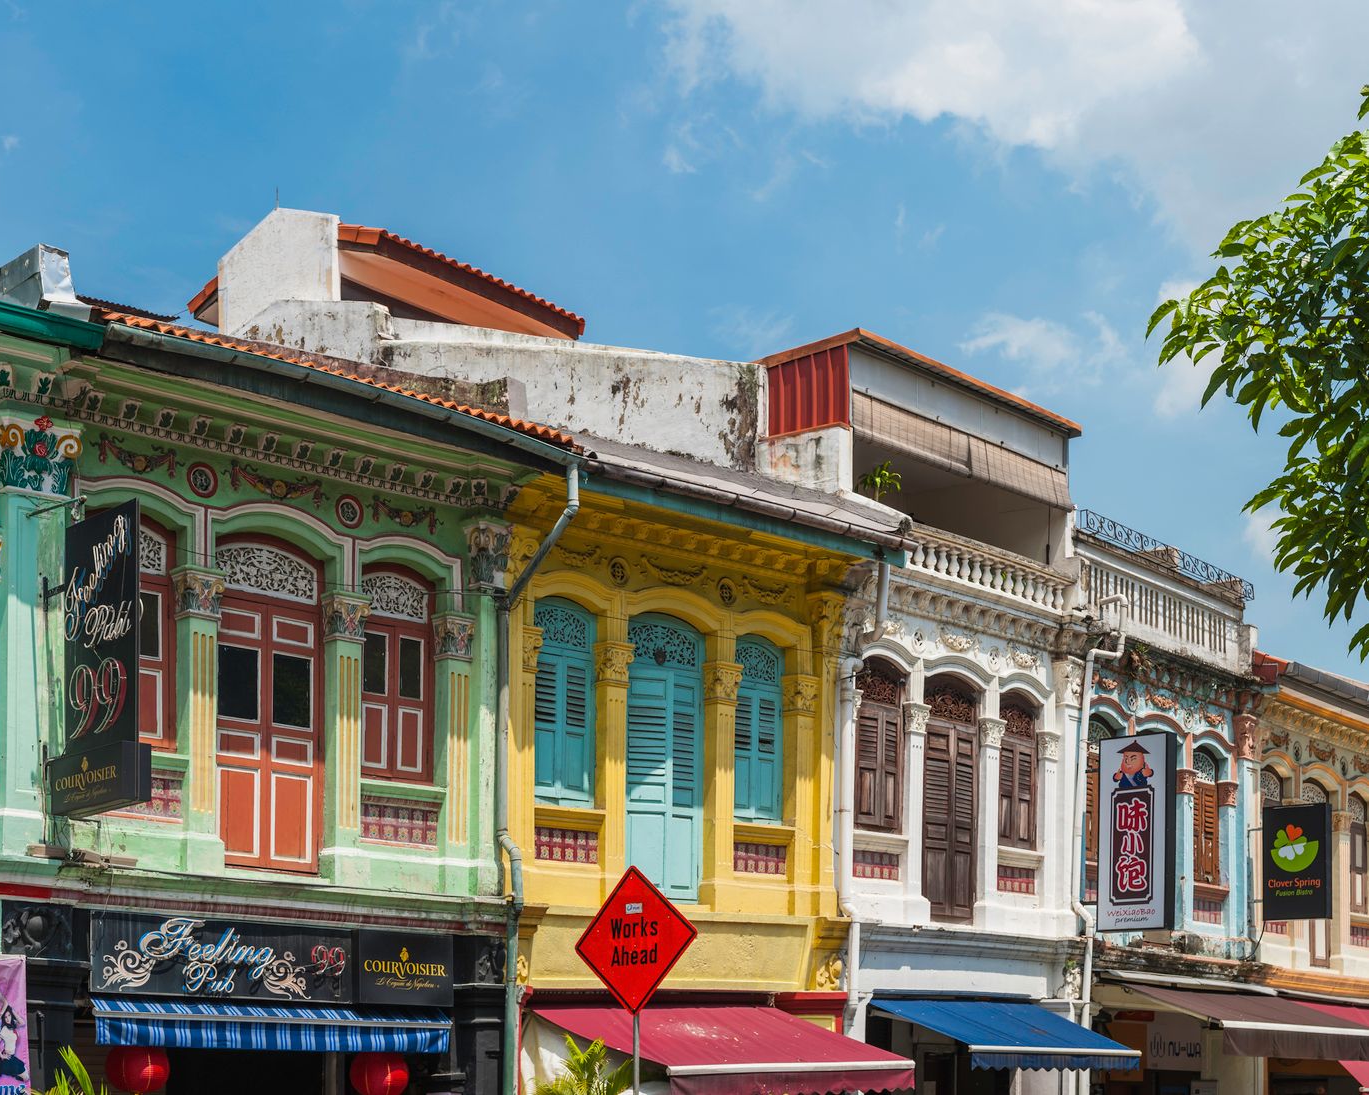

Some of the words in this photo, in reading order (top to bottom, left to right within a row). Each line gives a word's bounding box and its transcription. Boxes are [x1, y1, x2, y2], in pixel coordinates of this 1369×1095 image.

[69, 657, 127, 739] 99
[55, 765, 117, 791] COURVOISIER
[1268, 879, 1292, 889] Clover
[1294, 877, 1321, 889] Spring
[1275, 889, 1295, 897] Fusion
[1296, 888, 1313, 896] Bistro
[611, 916, 658, 940] Works
[1114, 916, 1149, 927] premium
[139, 917, 276, 981] Feeling
[311, 944, 346, 976] 99
[611, 943, 658, 967] Ahead
[183, 961, 235, 994] Pub
[364, 959, 446, 980] COURVOISIER
